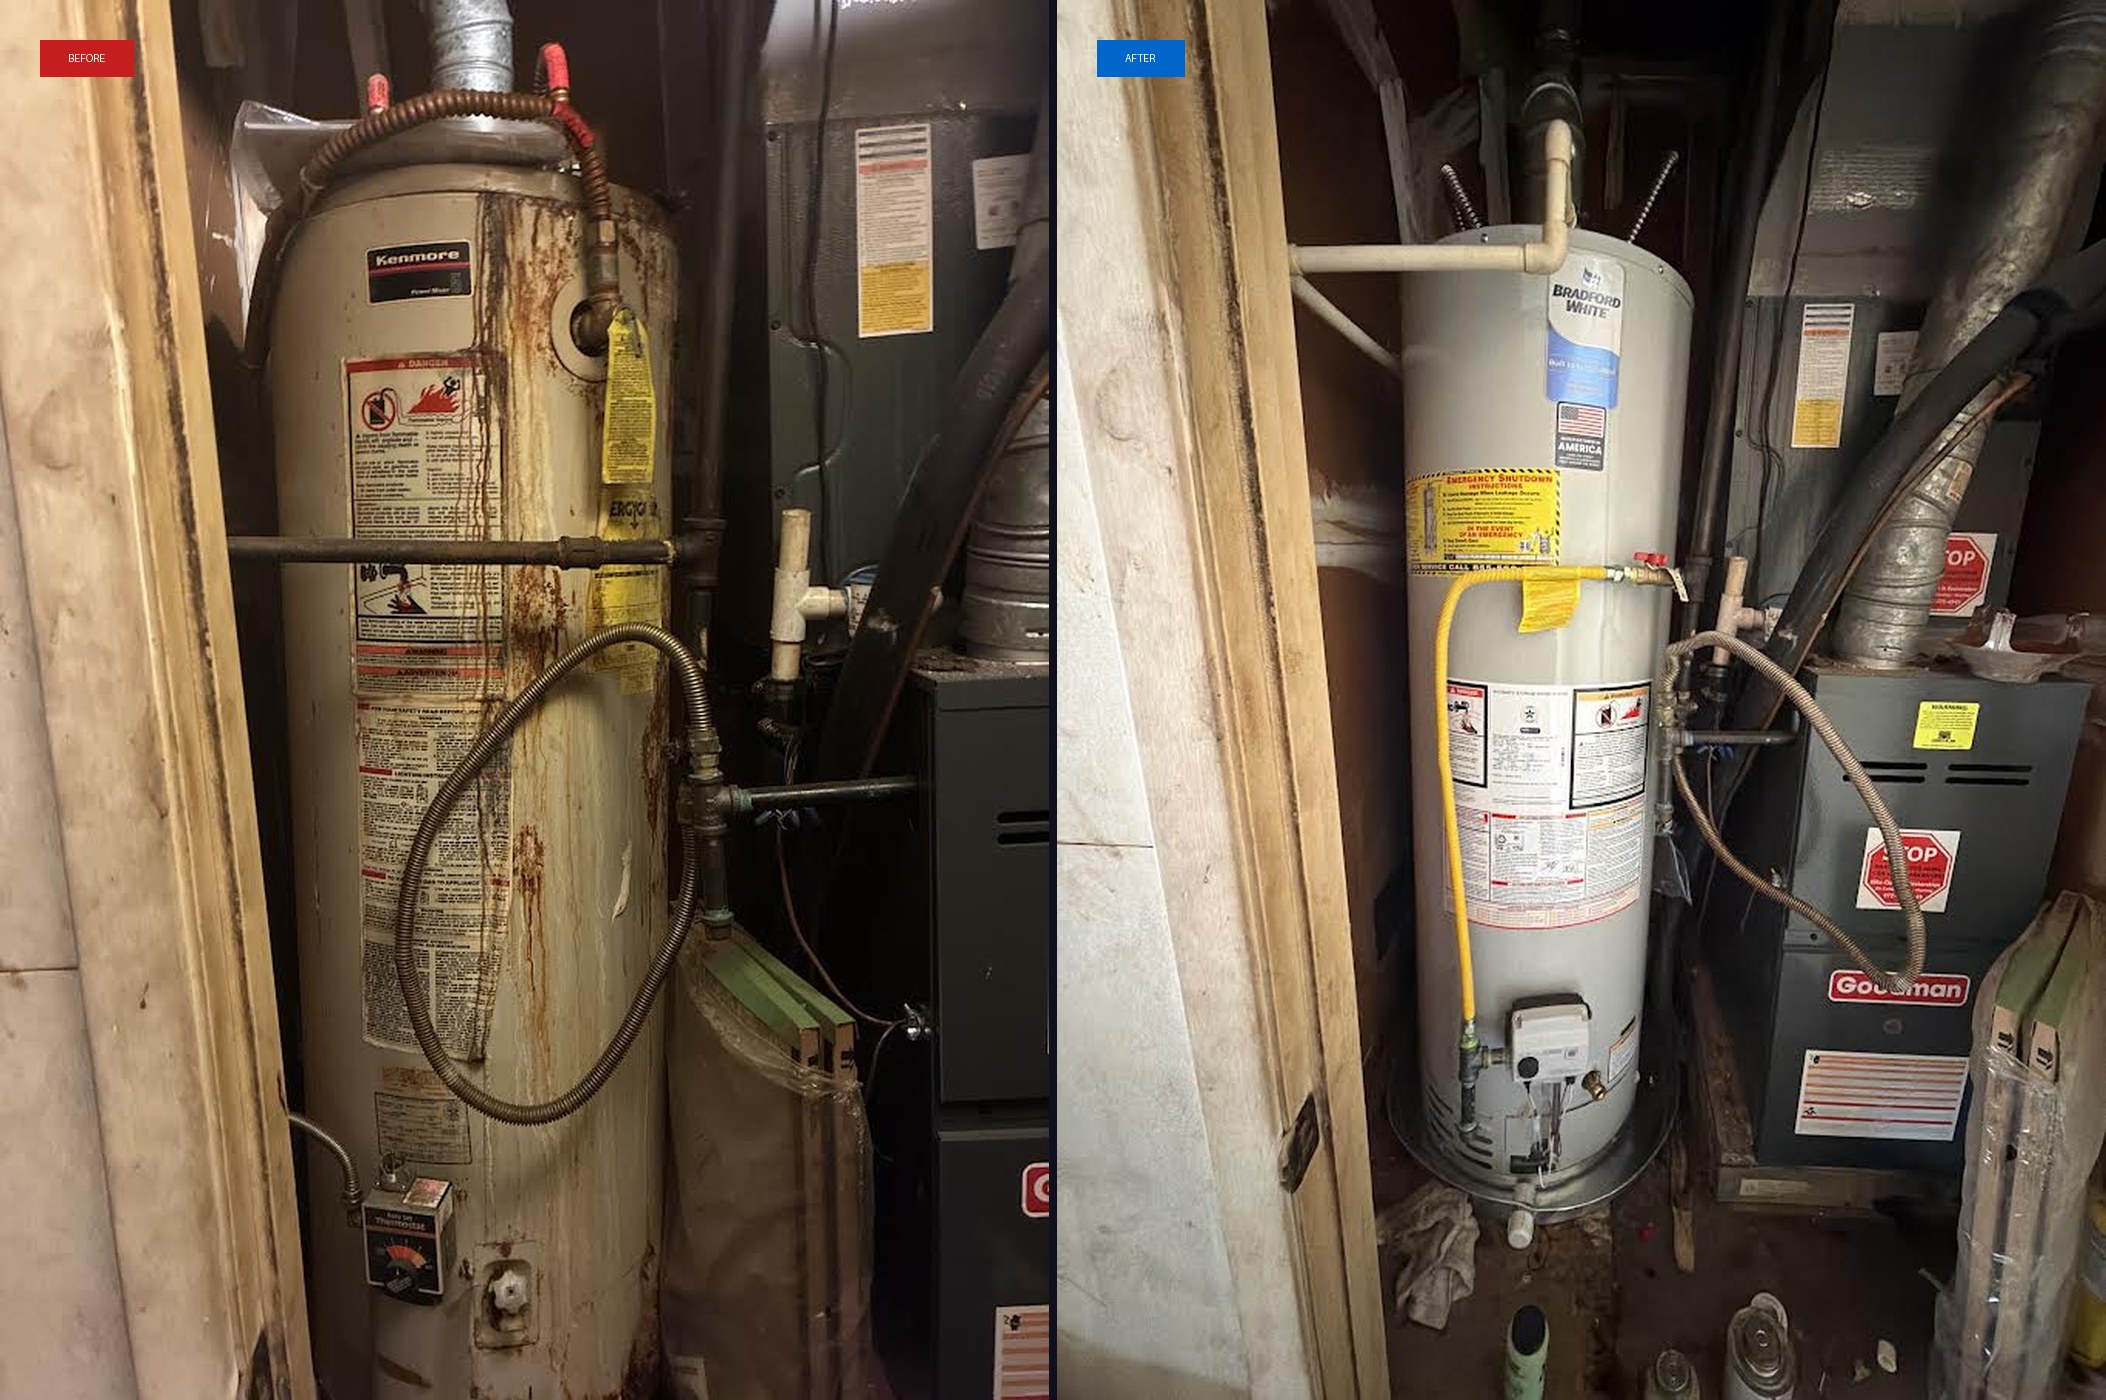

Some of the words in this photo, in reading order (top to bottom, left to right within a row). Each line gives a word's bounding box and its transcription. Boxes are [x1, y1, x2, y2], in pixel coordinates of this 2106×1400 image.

[375, 250, 460, 266] Kenmore
[1552, 284, 1621, 308] BRADFORD
[1566, 299, 1607, 319] WHITE
[408, 358, 449, 369] DANGER
[1558, 442, 1602, 455] AMERICA
[1446, 476, 1495, 485] EMERGENCY
[1497, 473, 1554, 484] SHUTDOWN
[1448, 563, 1470, 572] CALL
[1881, 846, 1938, 863] OP
[375, 1216, 427, 1232] Thermostat
